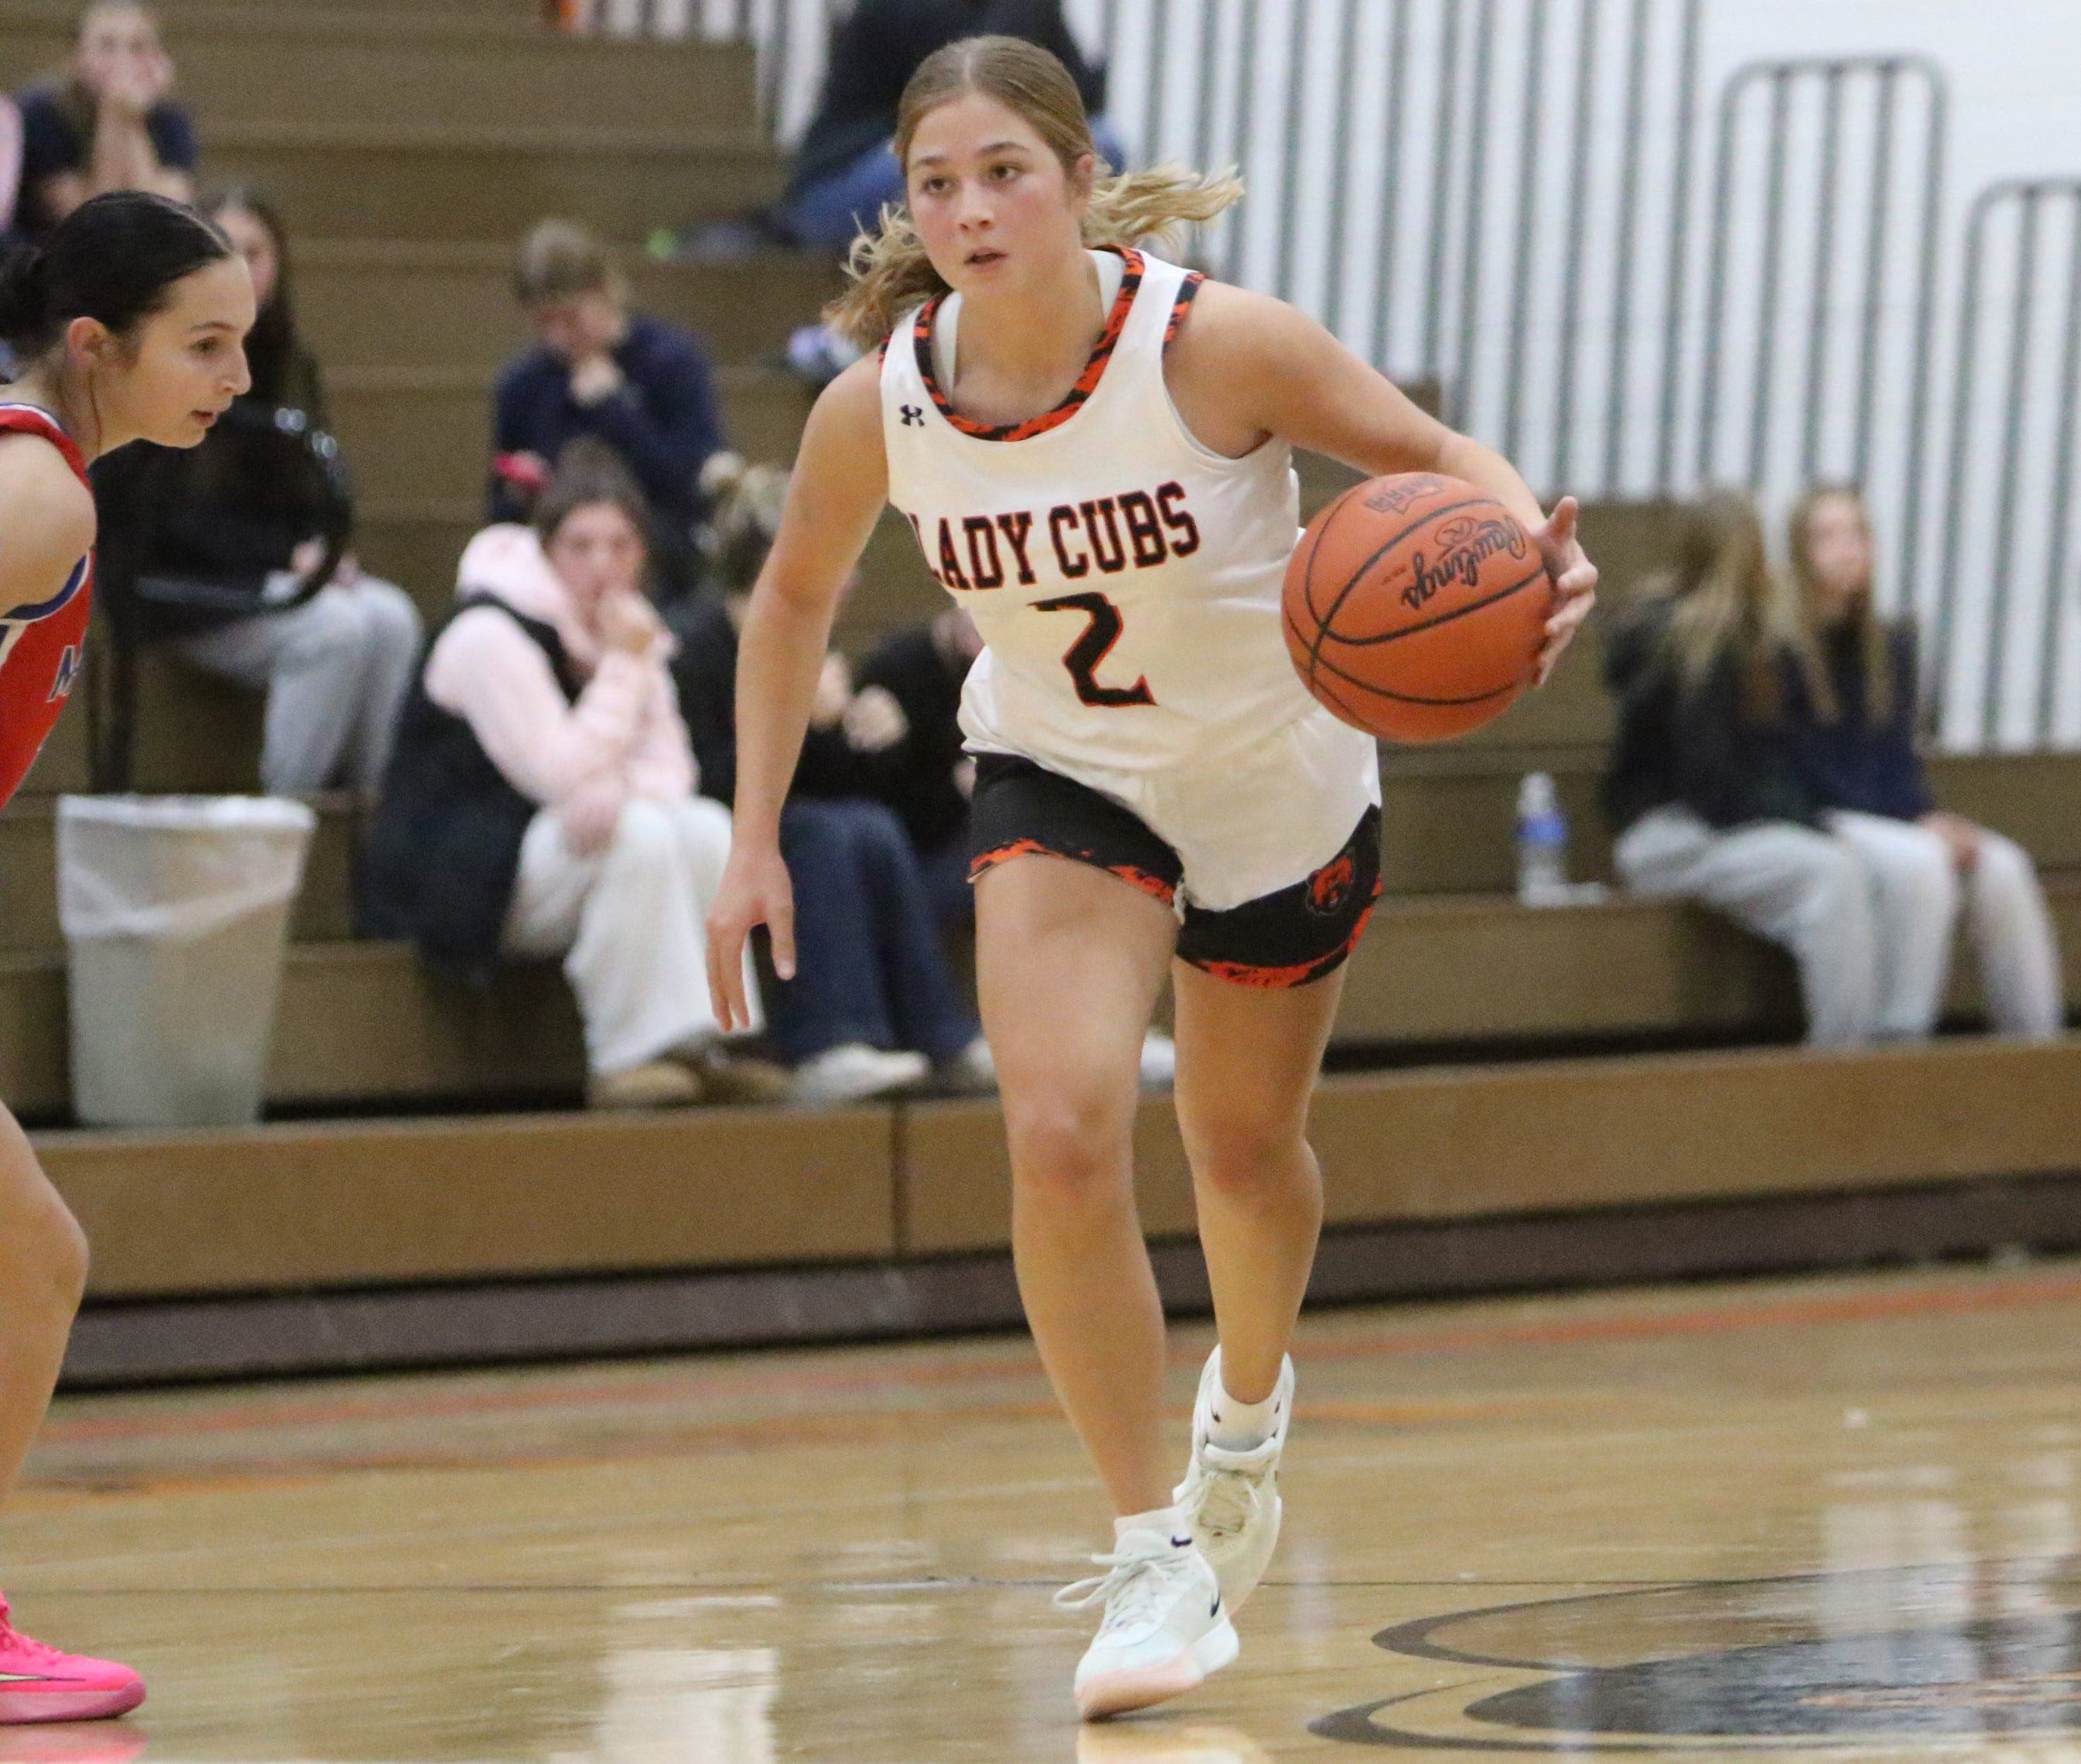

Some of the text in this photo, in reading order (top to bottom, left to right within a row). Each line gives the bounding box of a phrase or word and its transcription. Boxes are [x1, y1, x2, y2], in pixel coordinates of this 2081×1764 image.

[1048, 481, 1200, 581] CUBS
[1400, 515, 1526, 611] Rawlings
[1027, 591, 1159, 707] 2
